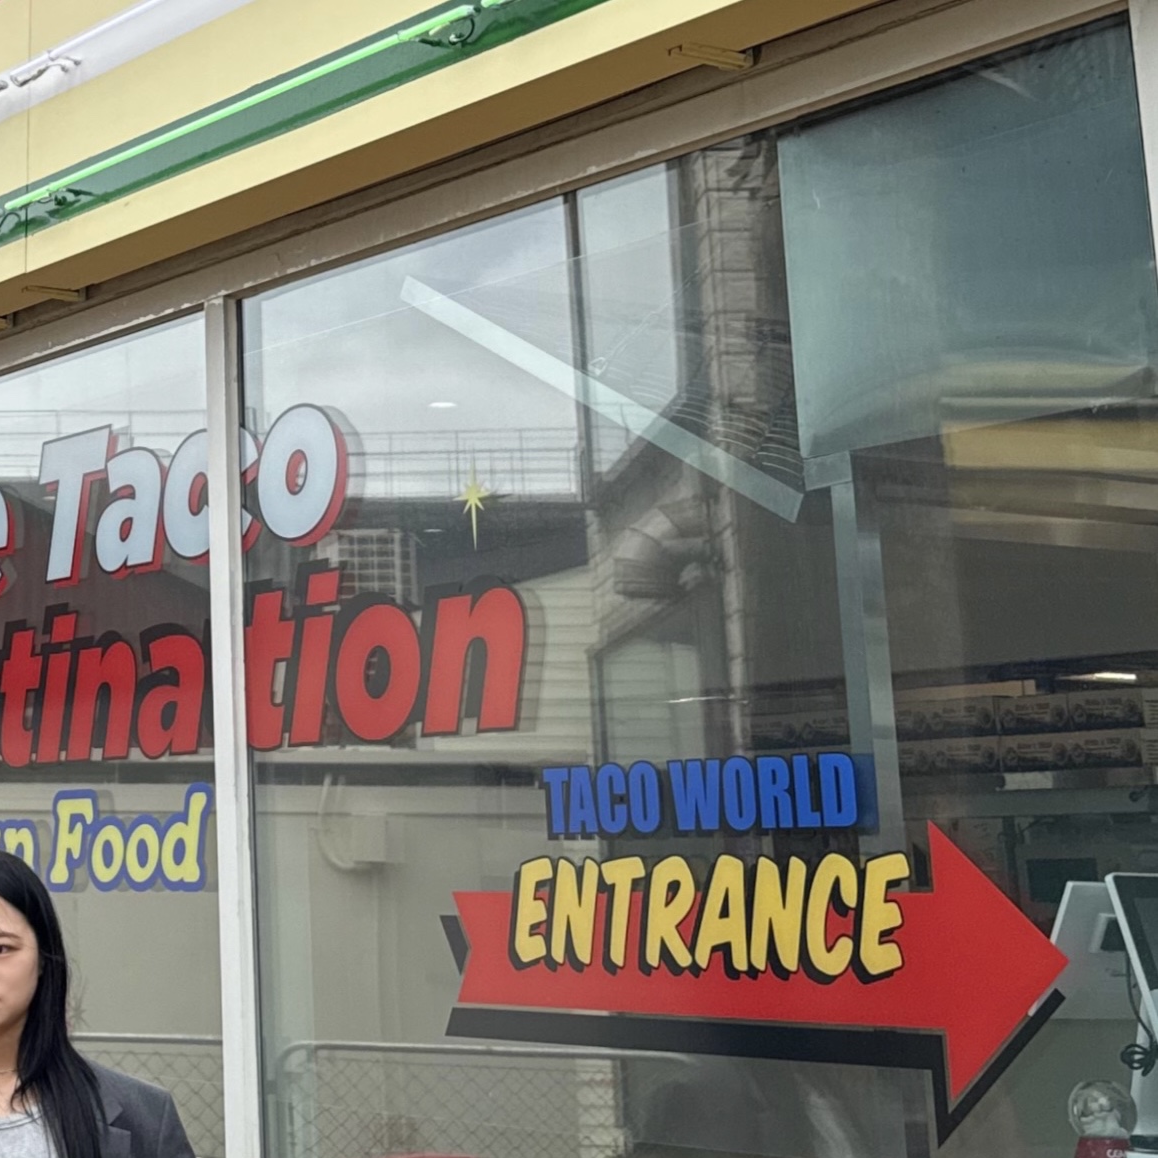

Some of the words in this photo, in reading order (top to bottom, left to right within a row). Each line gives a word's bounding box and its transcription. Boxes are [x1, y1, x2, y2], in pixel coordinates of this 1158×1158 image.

[38, 404, 352, 592] Taco
[48, 782, 215, 893] Food
[542, 758, 662, 838] TACO
[666, 751, 860, 834] WORLD
[510, 850, 912, 980] ENTRANCE
